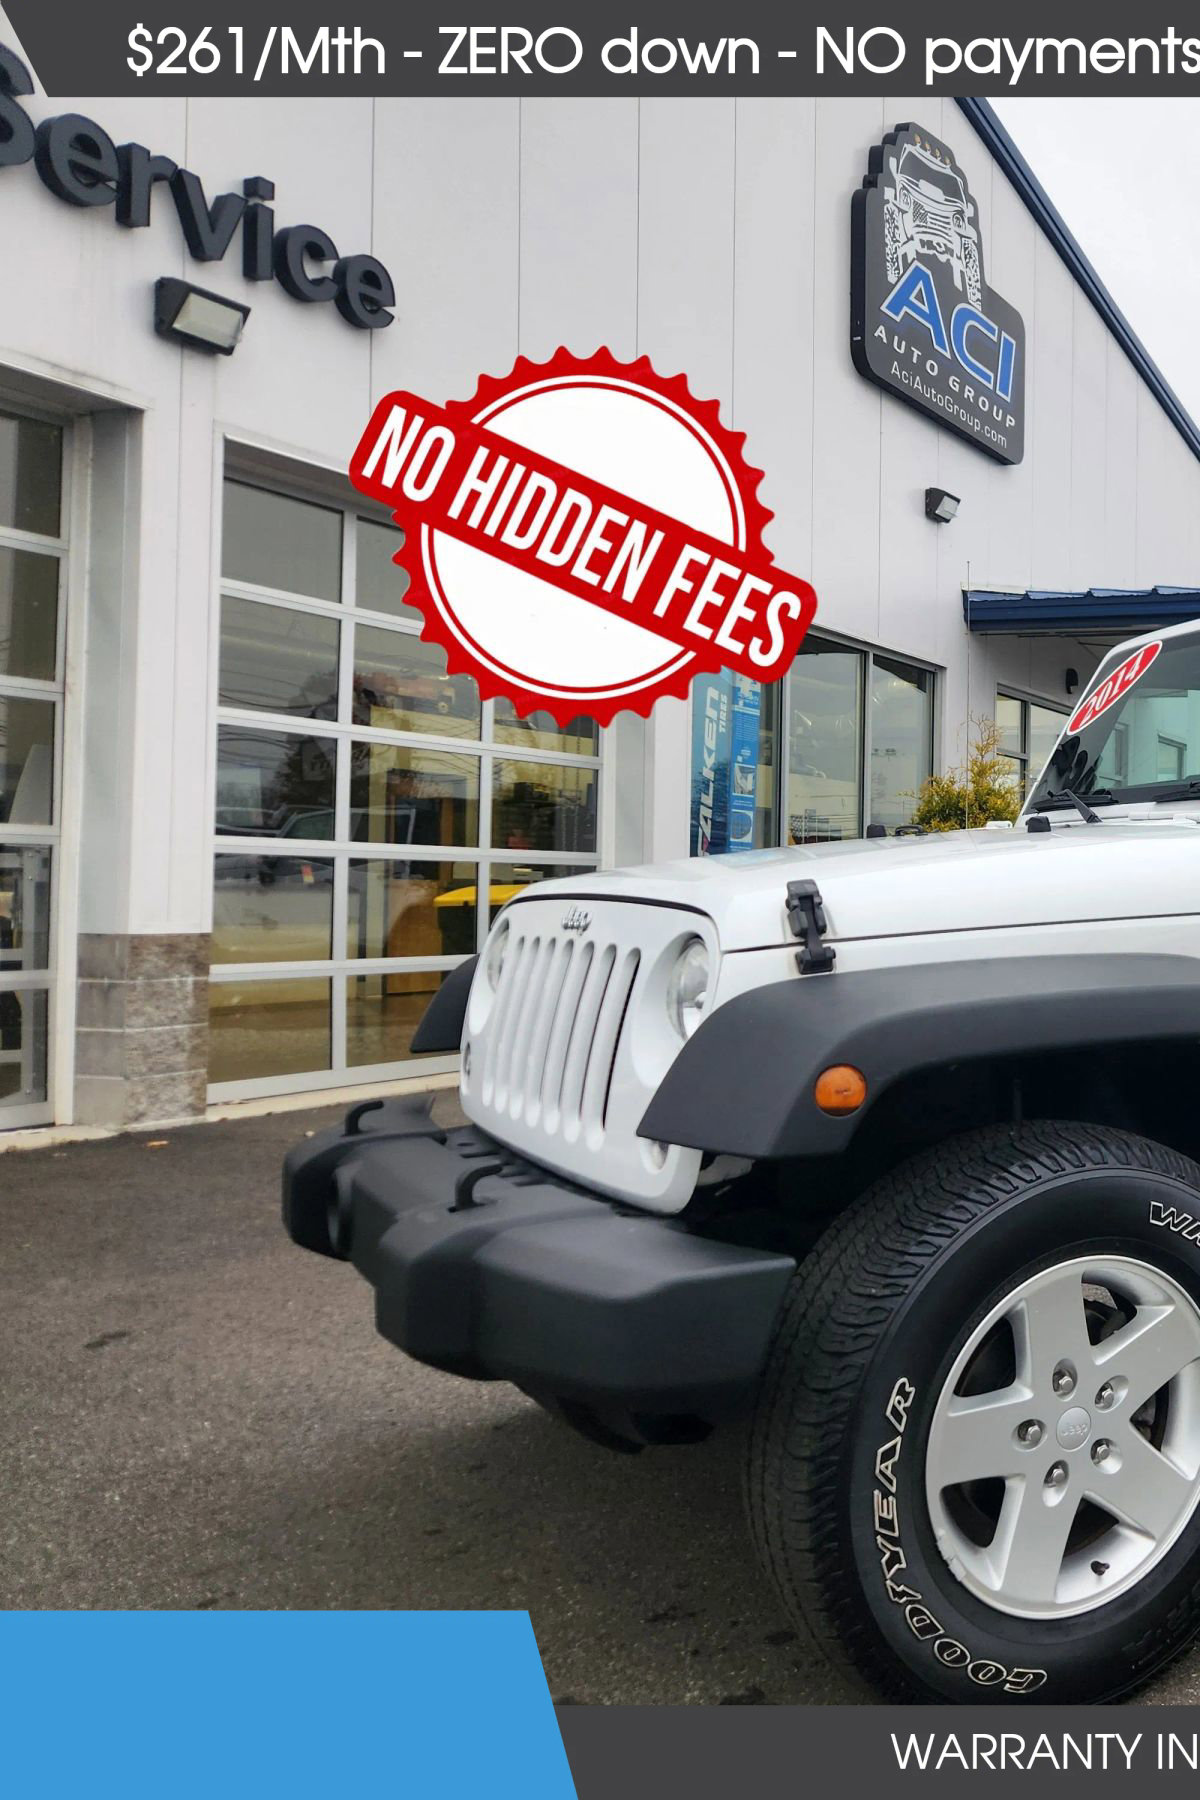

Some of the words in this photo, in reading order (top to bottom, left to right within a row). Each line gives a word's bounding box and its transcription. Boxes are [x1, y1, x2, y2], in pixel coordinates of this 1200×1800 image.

[874, 325, 939, 377] AUTO
[948, 375, 1016, 428] GROUP
[880, 260, 1016, 403] ACI
[891, 361, 1007, 449] AciAutoGroup.com
[719, 693, 729, 734] TIRES
[1079, 650, 1145, 729] 2014
[873, 1376, 1048, 1694] GOODYEAR
